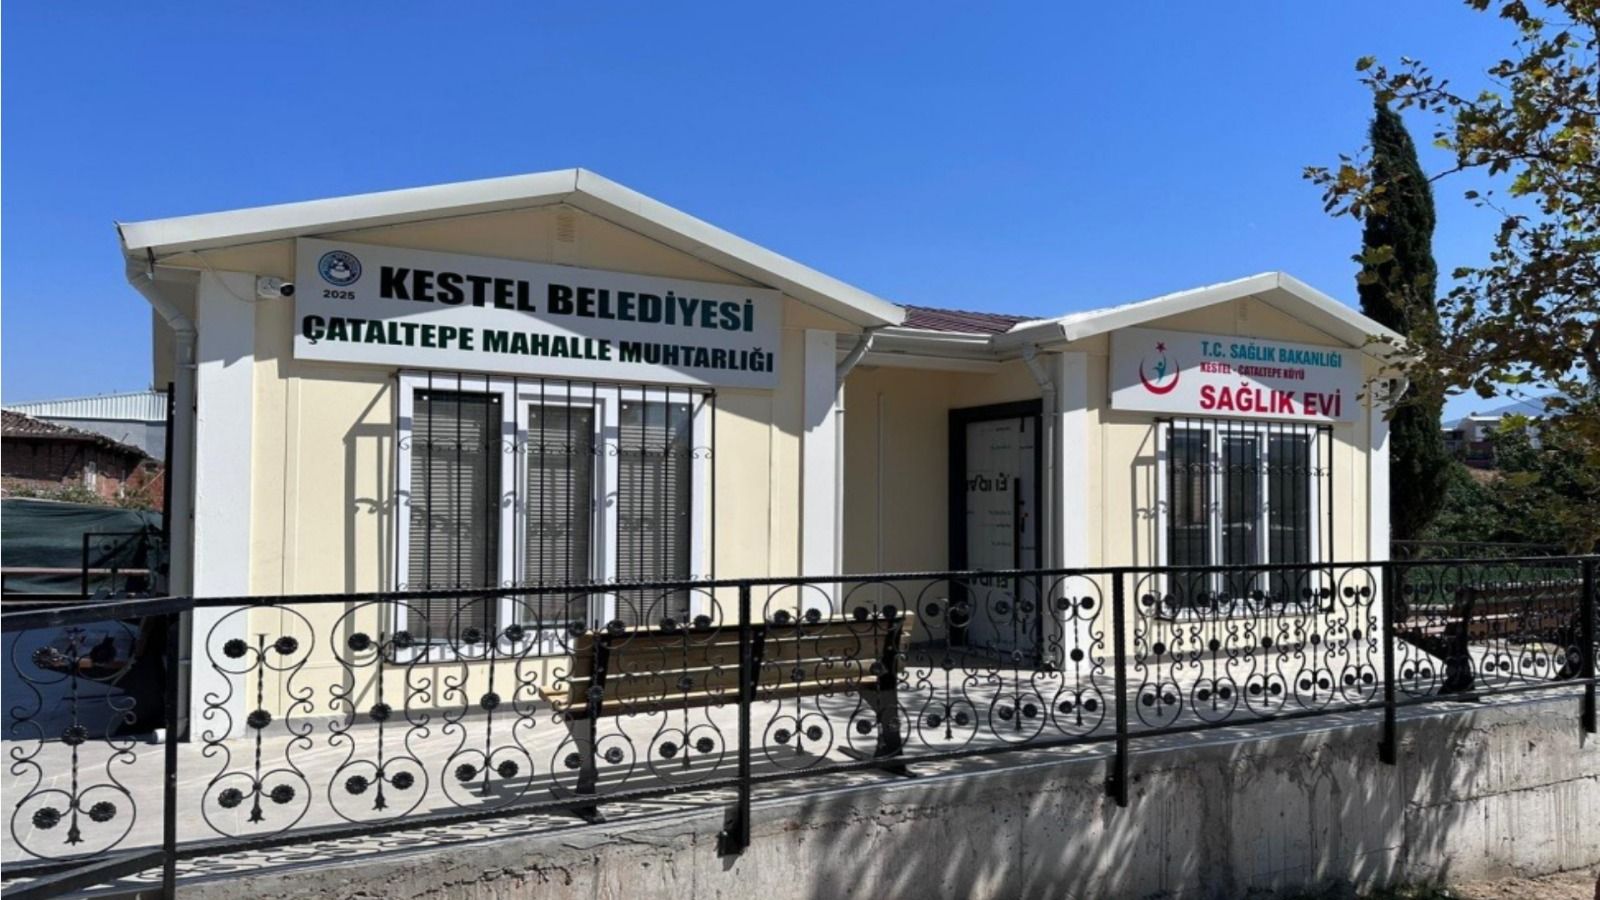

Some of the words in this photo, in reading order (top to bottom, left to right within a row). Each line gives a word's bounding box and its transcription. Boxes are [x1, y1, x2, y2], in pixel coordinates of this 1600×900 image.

[322, 289, 355, 300] 2025
[380, 266, 536, 312] KESTEL
[548, 283, 753, 332] BELEDİYESİ
[302, 315, 474, 351] ÇATALTEPE
[483, 329, 612, 361] MAHALLE
[619, 341, 773, 373] MUHTARLIĞI
[1201, 341, 1226, 358] T.C.
[1230, 342, 1275, 362] SAĞLIK
[1279, 348, 1342, 368] BAKANLIĞI
[1200, 362, 1231, 374] KESTEL
[1200, 381, 1294, 414] SAĞLIK
[1304, 388, 1341, 417] EVİ
